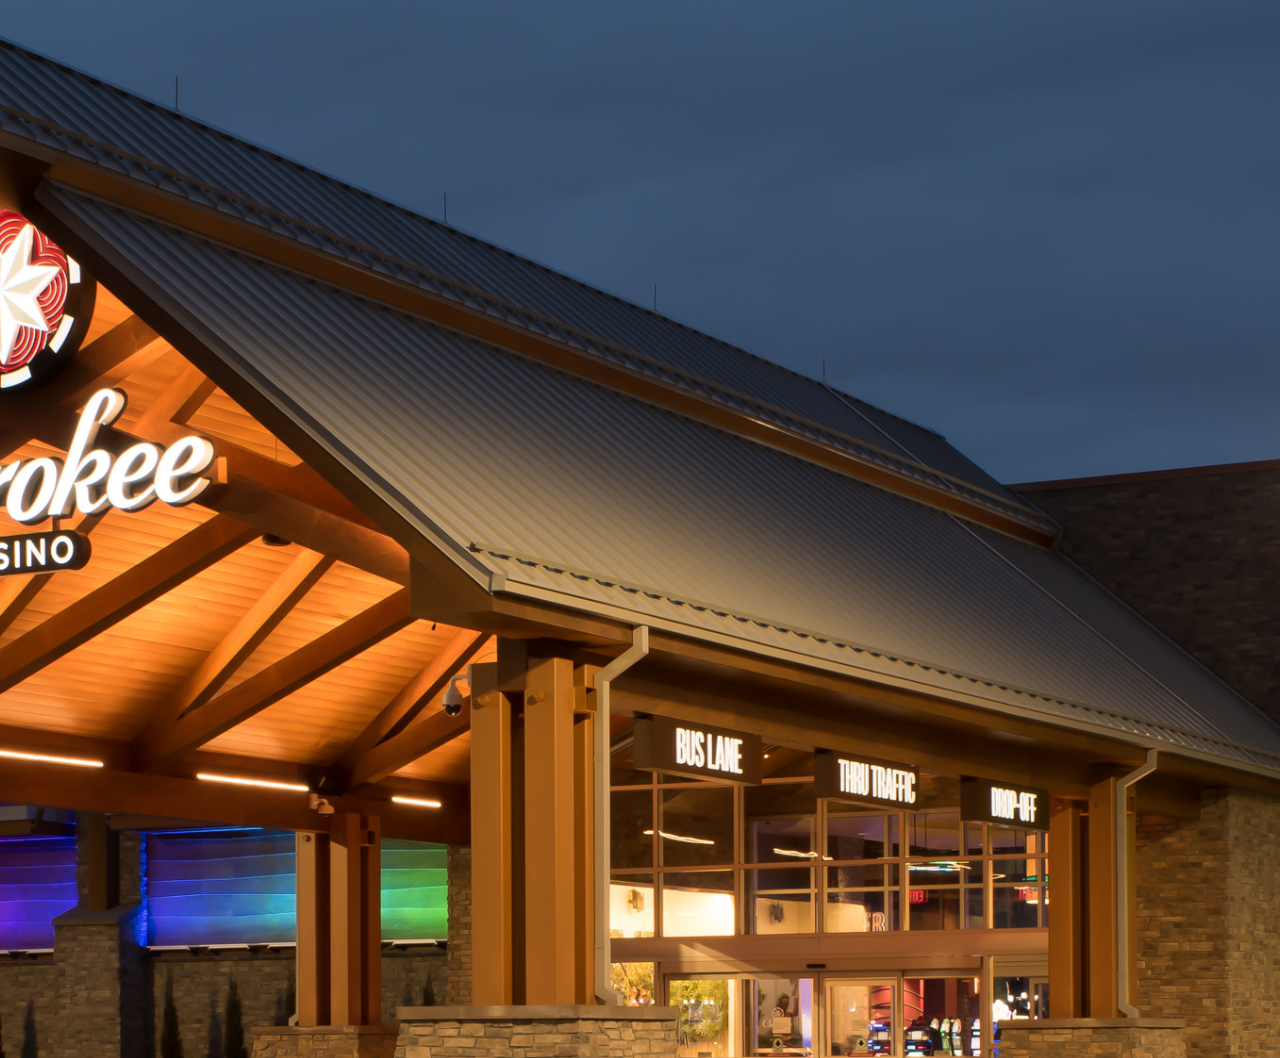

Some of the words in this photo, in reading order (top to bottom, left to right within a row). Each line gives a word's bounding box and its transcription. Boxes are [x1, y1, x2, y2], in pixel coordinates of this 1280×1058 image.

[675, 727, 705, 768] BUS
[706, 733, 744, 774] LANE
[837, 758, 869, 796] THRU
[870, 765, 916, 804] TRAFFIC
[990, 786, 1037, 823] DROP-OFF
